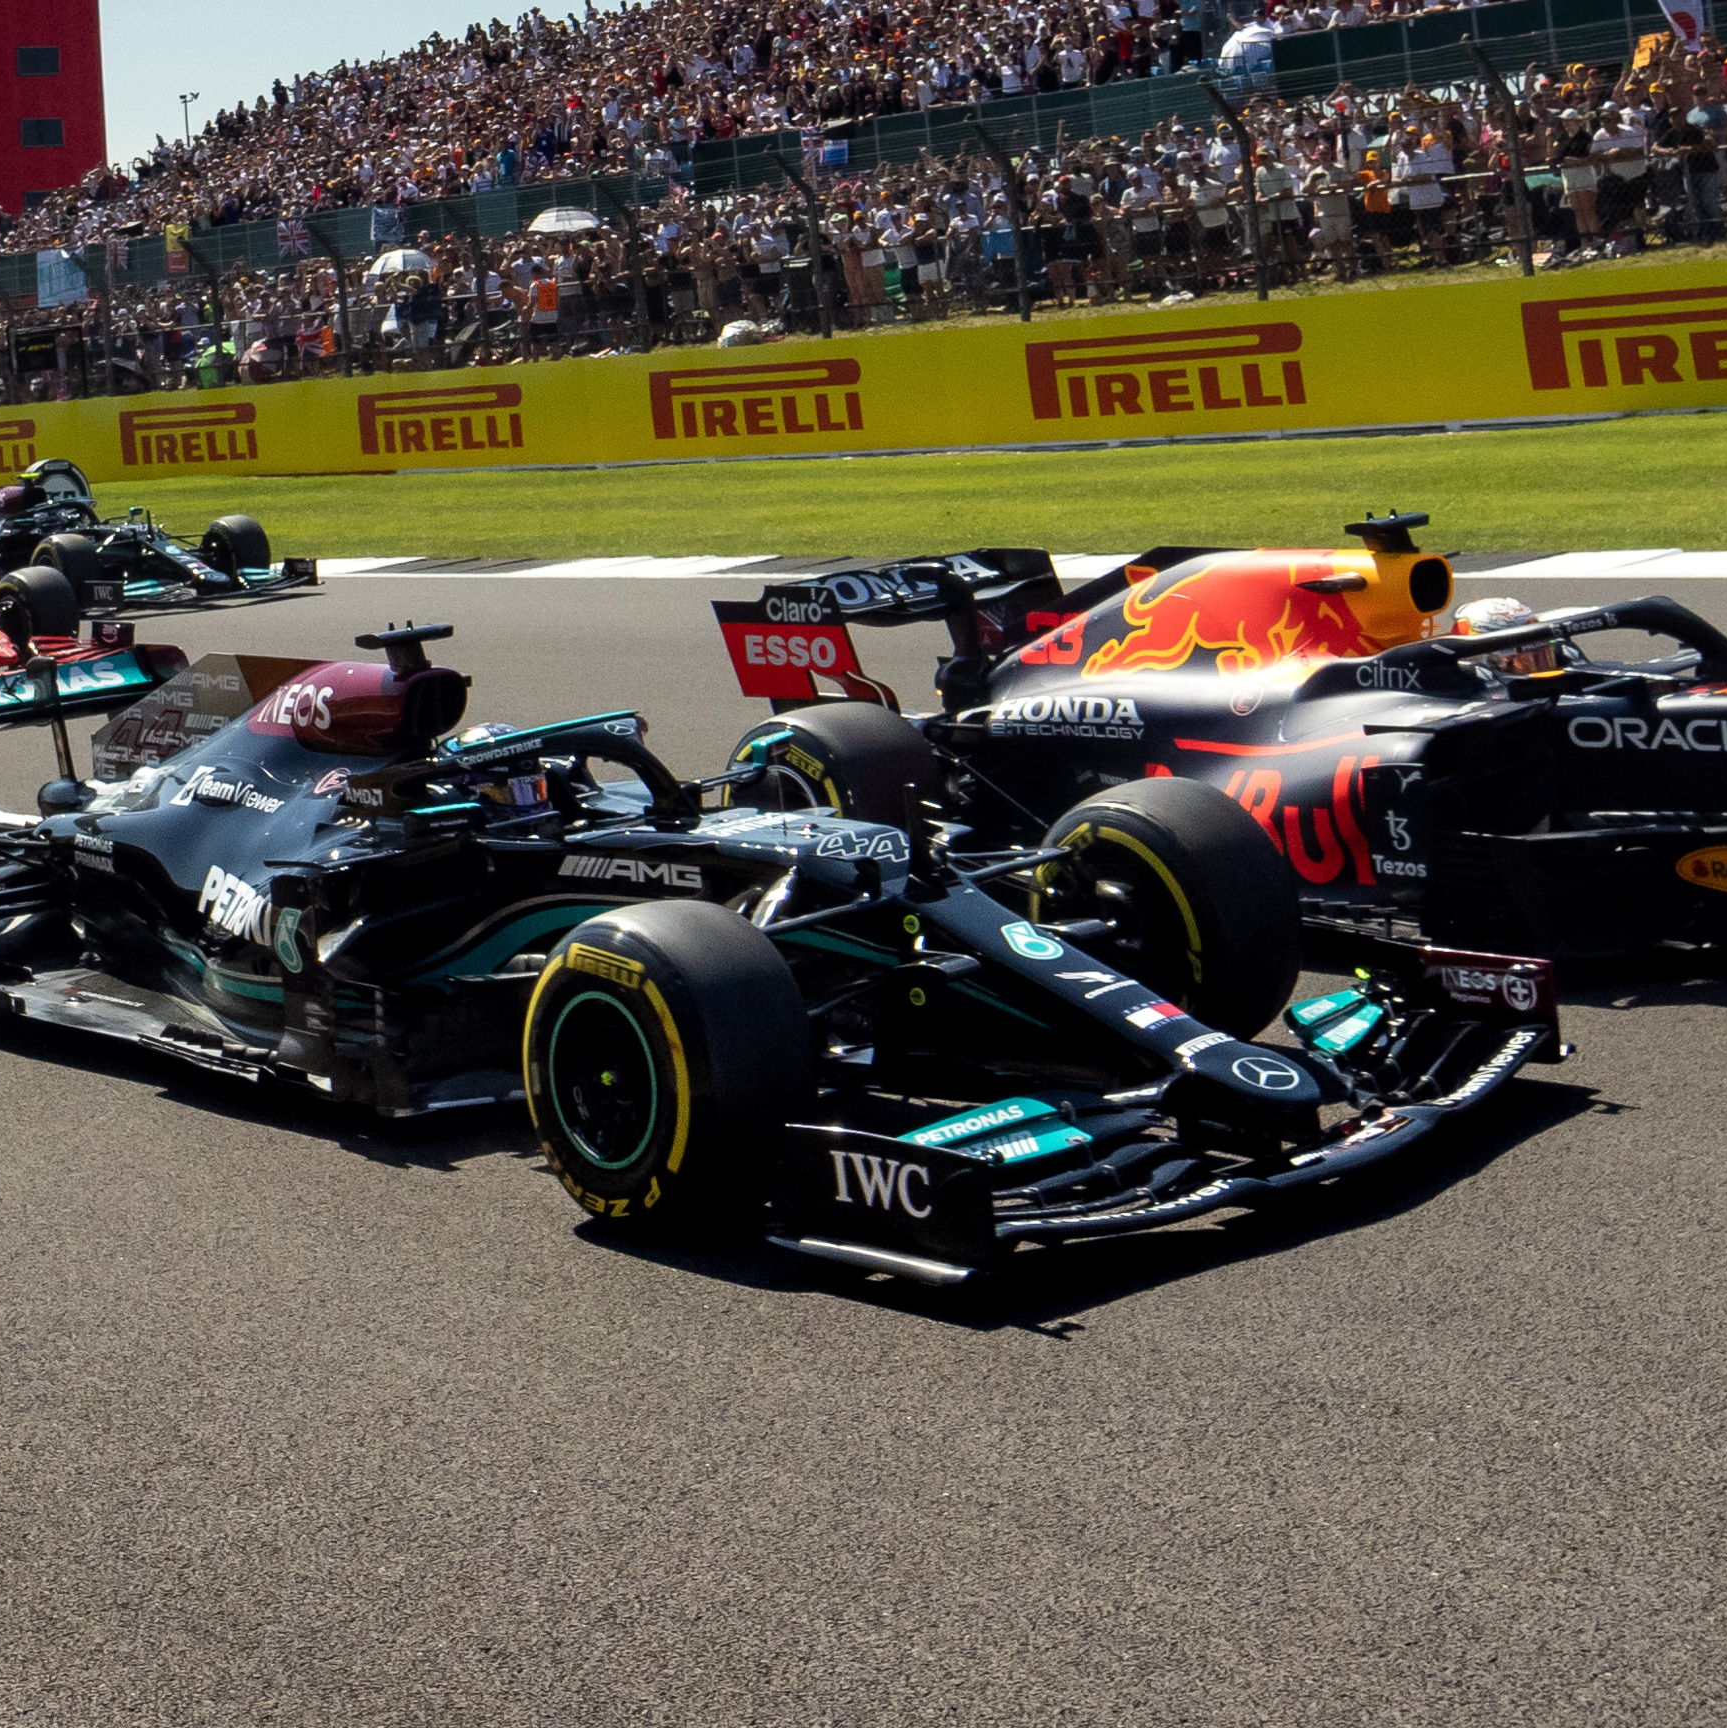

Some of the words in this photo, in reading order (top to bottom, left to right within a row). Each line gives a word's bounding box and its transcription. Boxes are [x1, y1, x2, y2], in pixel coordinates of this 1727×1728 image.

[1024, 321, 1307, 421] PIRELLI
[649, 357, 864, 440] PIRELLI
[118, 402, 259, 466] PIRELLI
[357, 383, 524, 455] PIRELLI
[93, 585, 115, 601] IWC
[744, 634, 837, 668] ESSO
[1020, 611, 1089, 665] 33
[189, 673, 241, 692] AMG
[1356, 659, 1423, 690] citrix
[257, 683, 335, 730] INEOS
[995, 695, 1141, 725] HONDA
[462, 737, 545, 767] CROWDSTRIKE
[198, 776, 286, 814] TeamViewer
[344, 787, 374, 806] AMD
[816, 830, 911, 863] 44
[607, 857, 703, 889] AMG
[1372, 854, 1428, 878] Tezos
[564, 942, 646, 990] PIRELLI
[1442, 967, 1498, 991] INEOS
[911, 1103, 1026, 1146] PETRONAS
[829, 1149, 933, 1219] IWC
